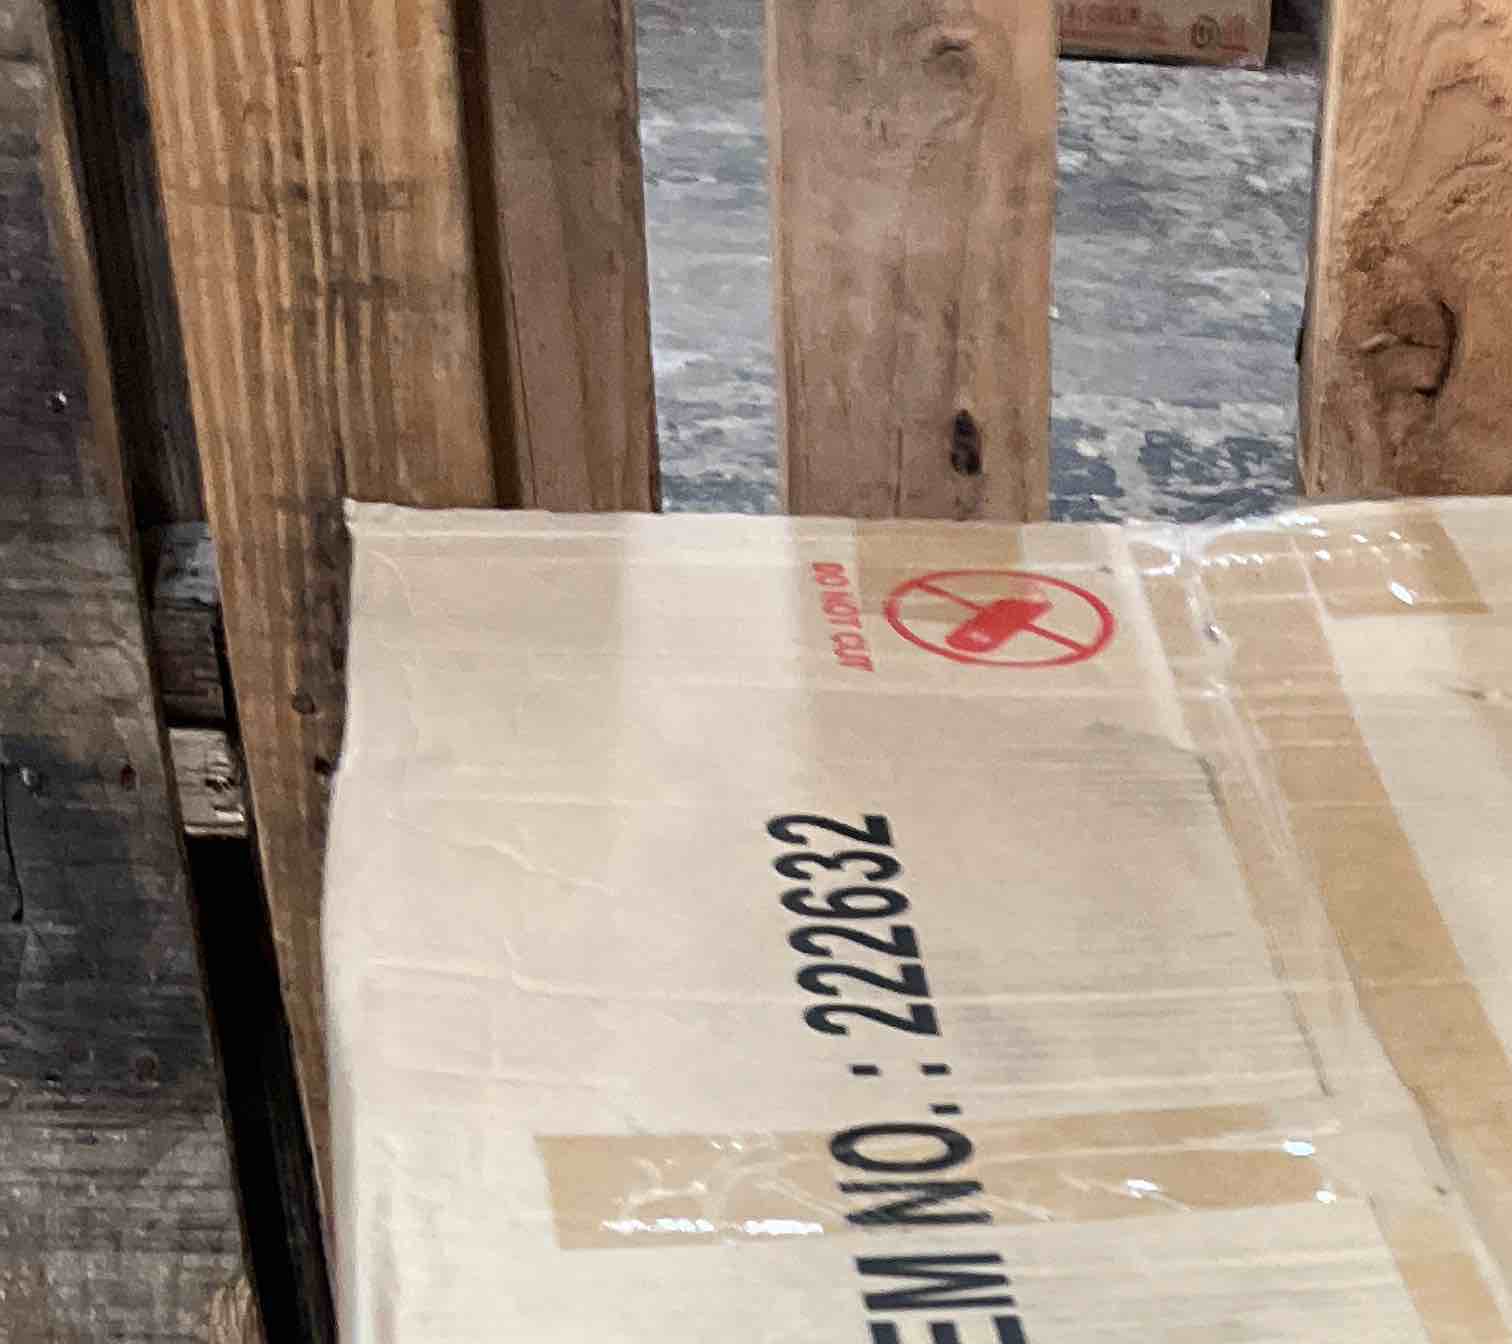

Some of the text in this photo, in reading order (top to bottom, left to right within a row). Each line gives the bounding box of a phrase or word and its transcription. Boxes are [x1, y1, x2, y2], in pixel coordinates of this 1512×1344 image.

[812, 563, 875, 672] DO NOT CUT
[766, 814, 942, 1037] 222632
